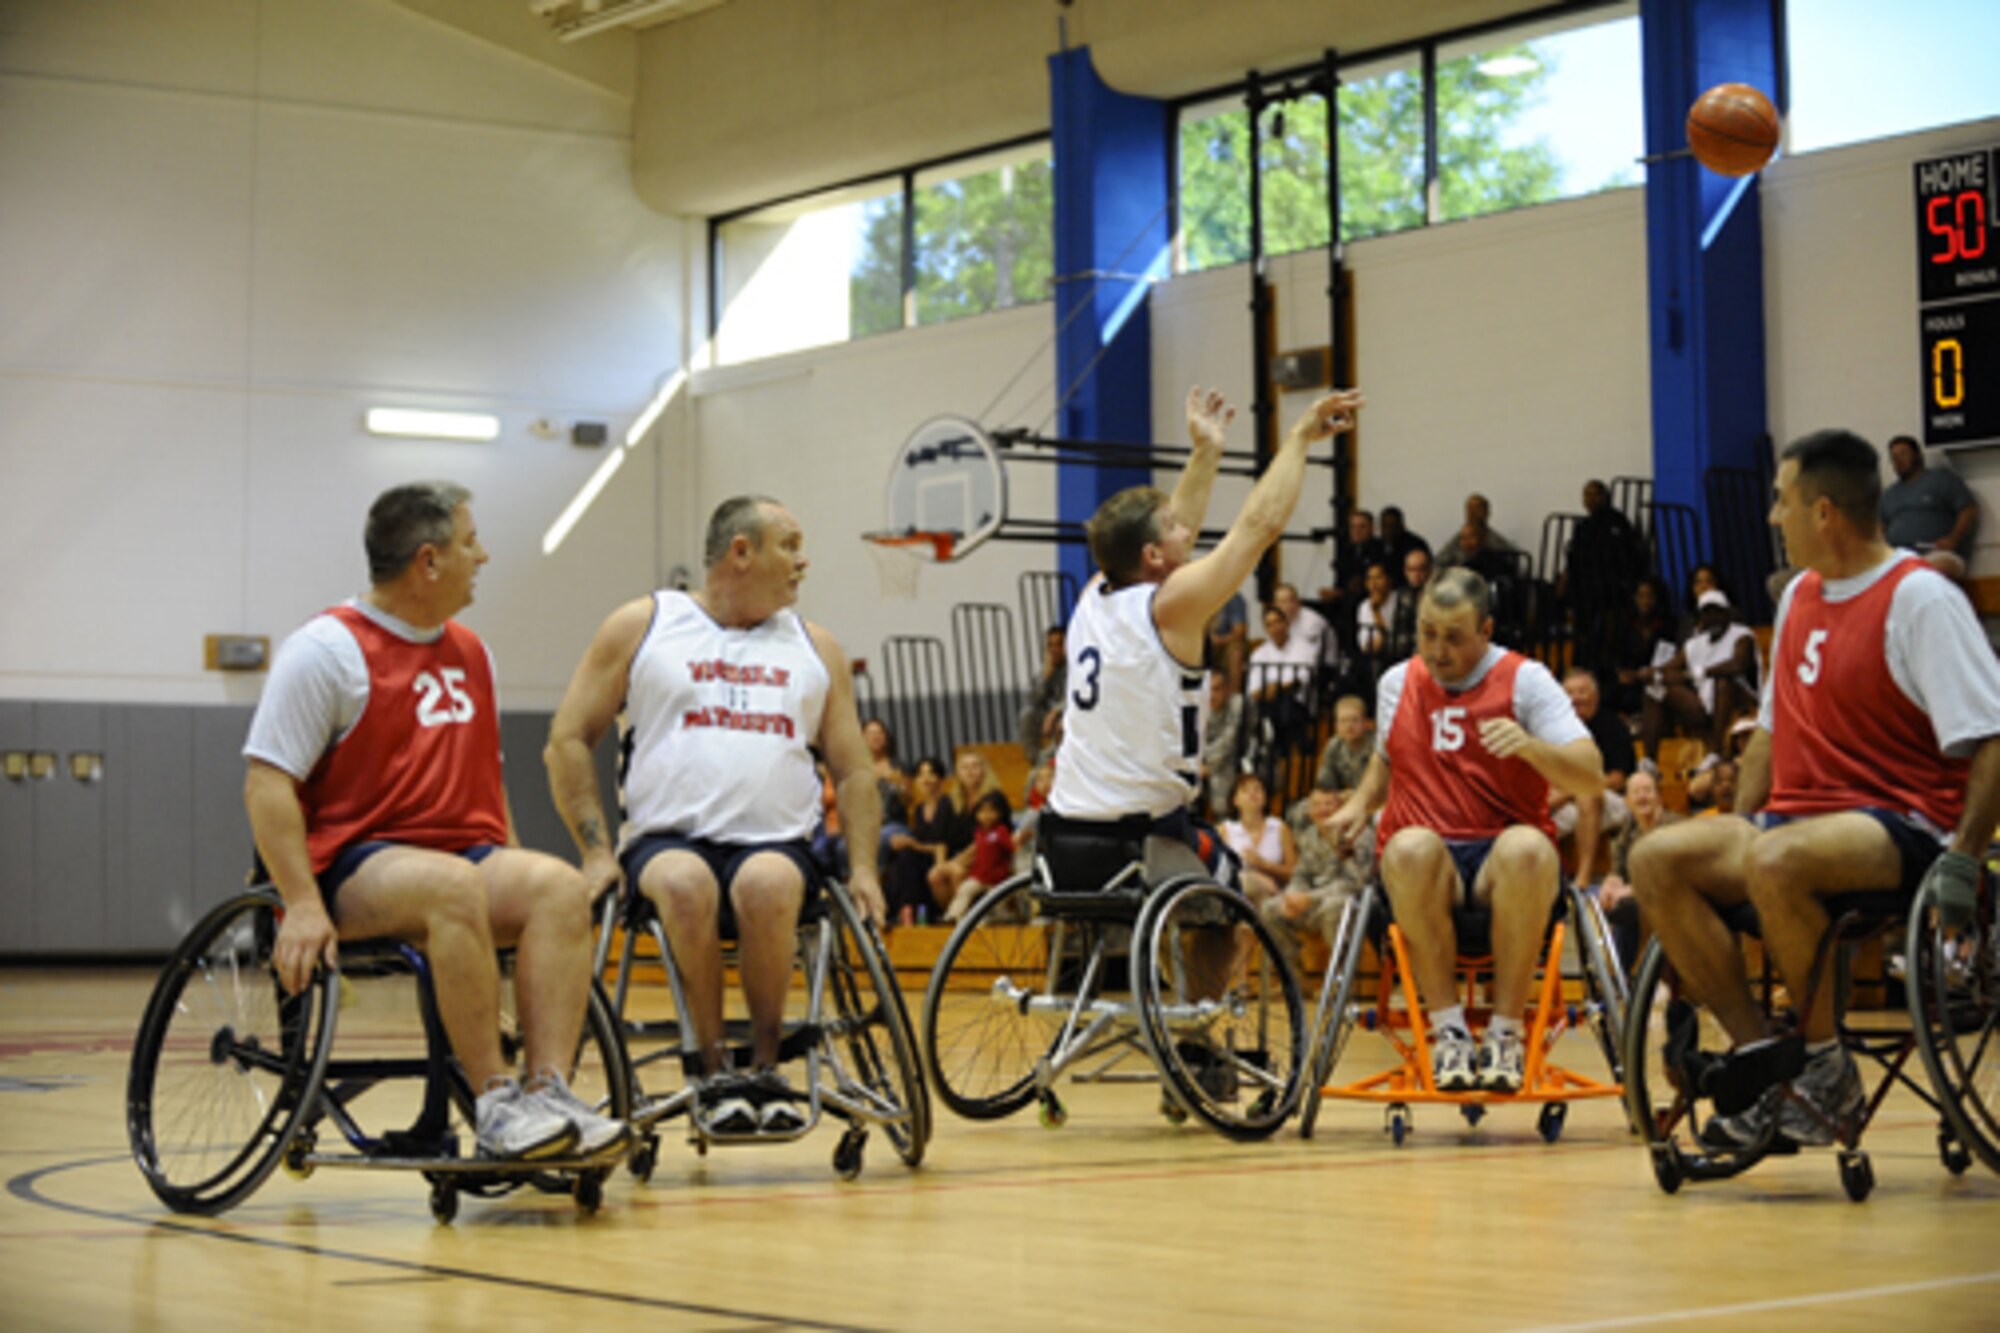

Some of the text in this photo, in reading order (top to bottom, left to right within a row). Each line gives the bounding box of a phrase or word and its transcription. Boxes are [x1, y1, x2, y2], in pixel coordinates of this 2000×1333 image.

[1920, 155, 1985, 195] HOME
[1927, 191, 1985, 263] 50
[1933, 338, 1964, 407] 0
[1073, 647, 1101, 711] 3
[1797, 629, 1828, 686] 5
[413, 667, 475, 727] 25
[1430, 707, 1466, 751] 15
